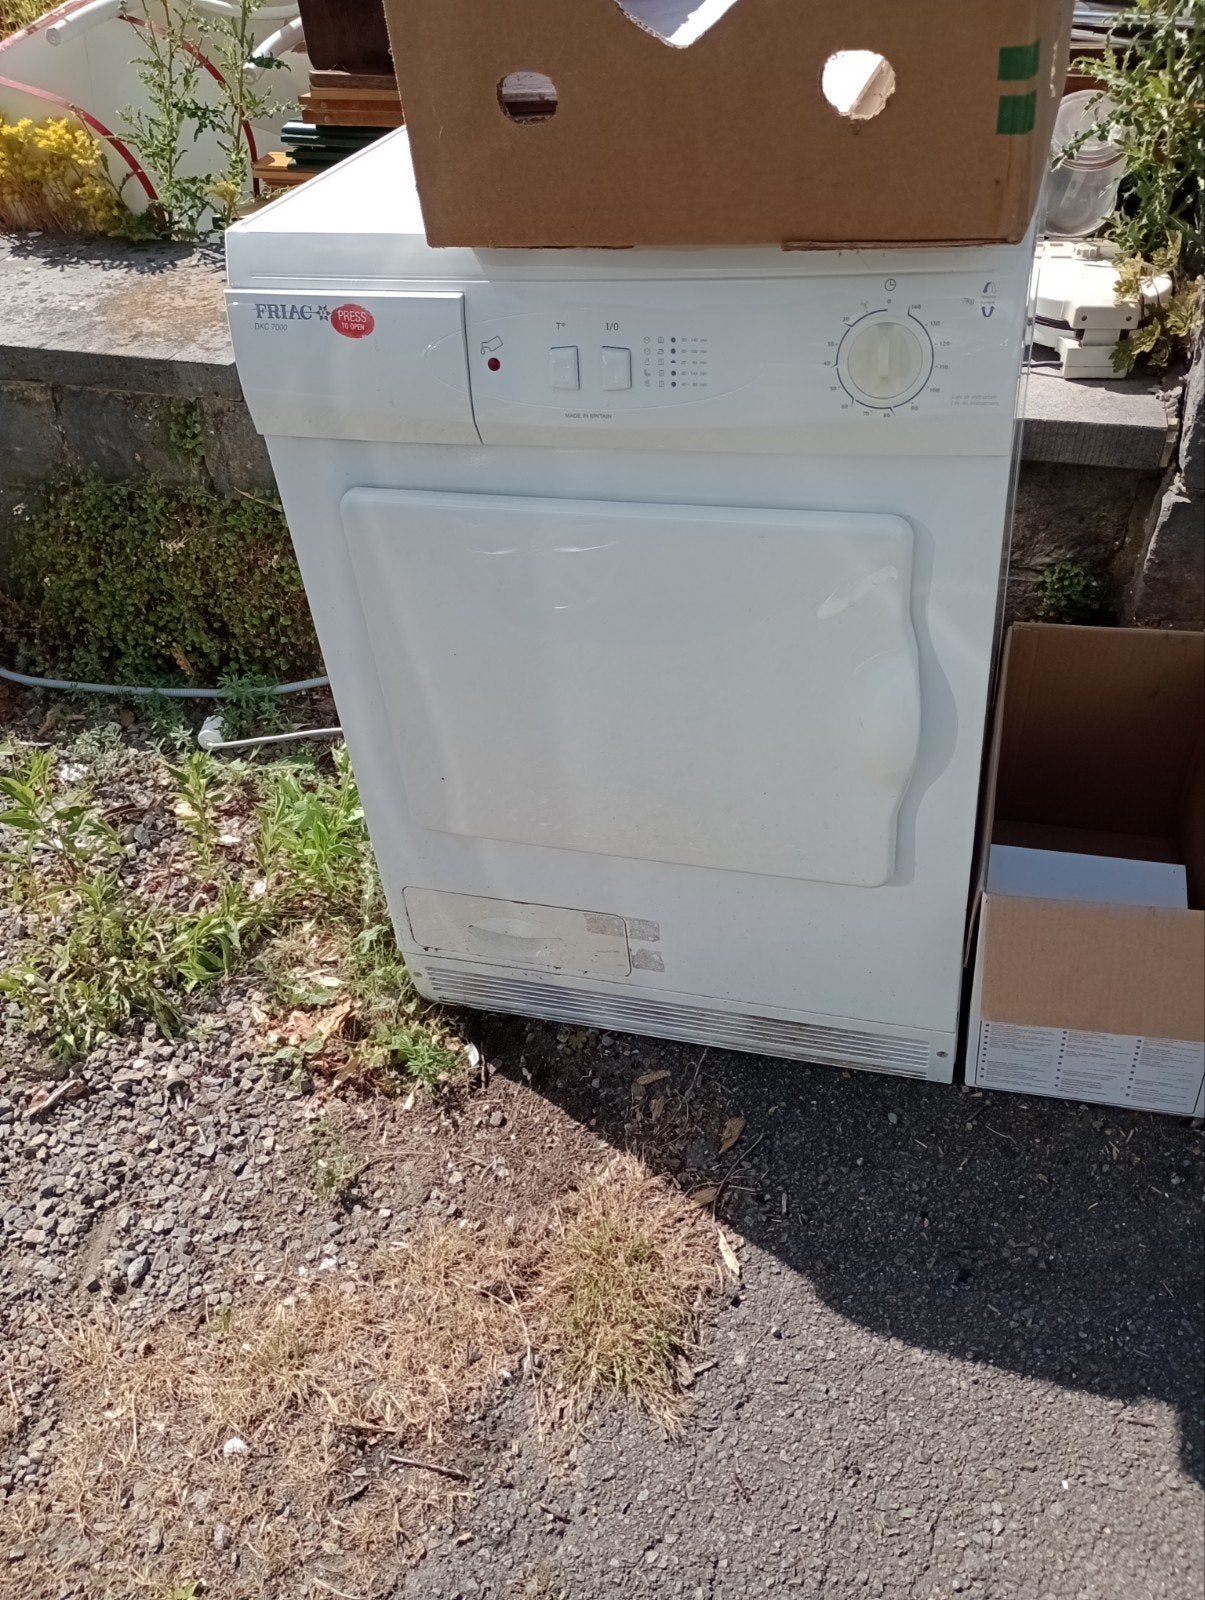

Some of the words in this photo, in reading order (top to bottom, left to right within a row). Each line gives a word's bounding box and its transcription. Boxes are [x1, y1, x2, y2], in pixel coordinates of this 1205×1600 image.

[254, 303, 313, 320] FRIAC
[338, 310, 367, 322] PRESS
[254, 322, 270, 330] DKC
[271, 323, 288, 331] 7000
[350, 323, 365, 331] OPEN
